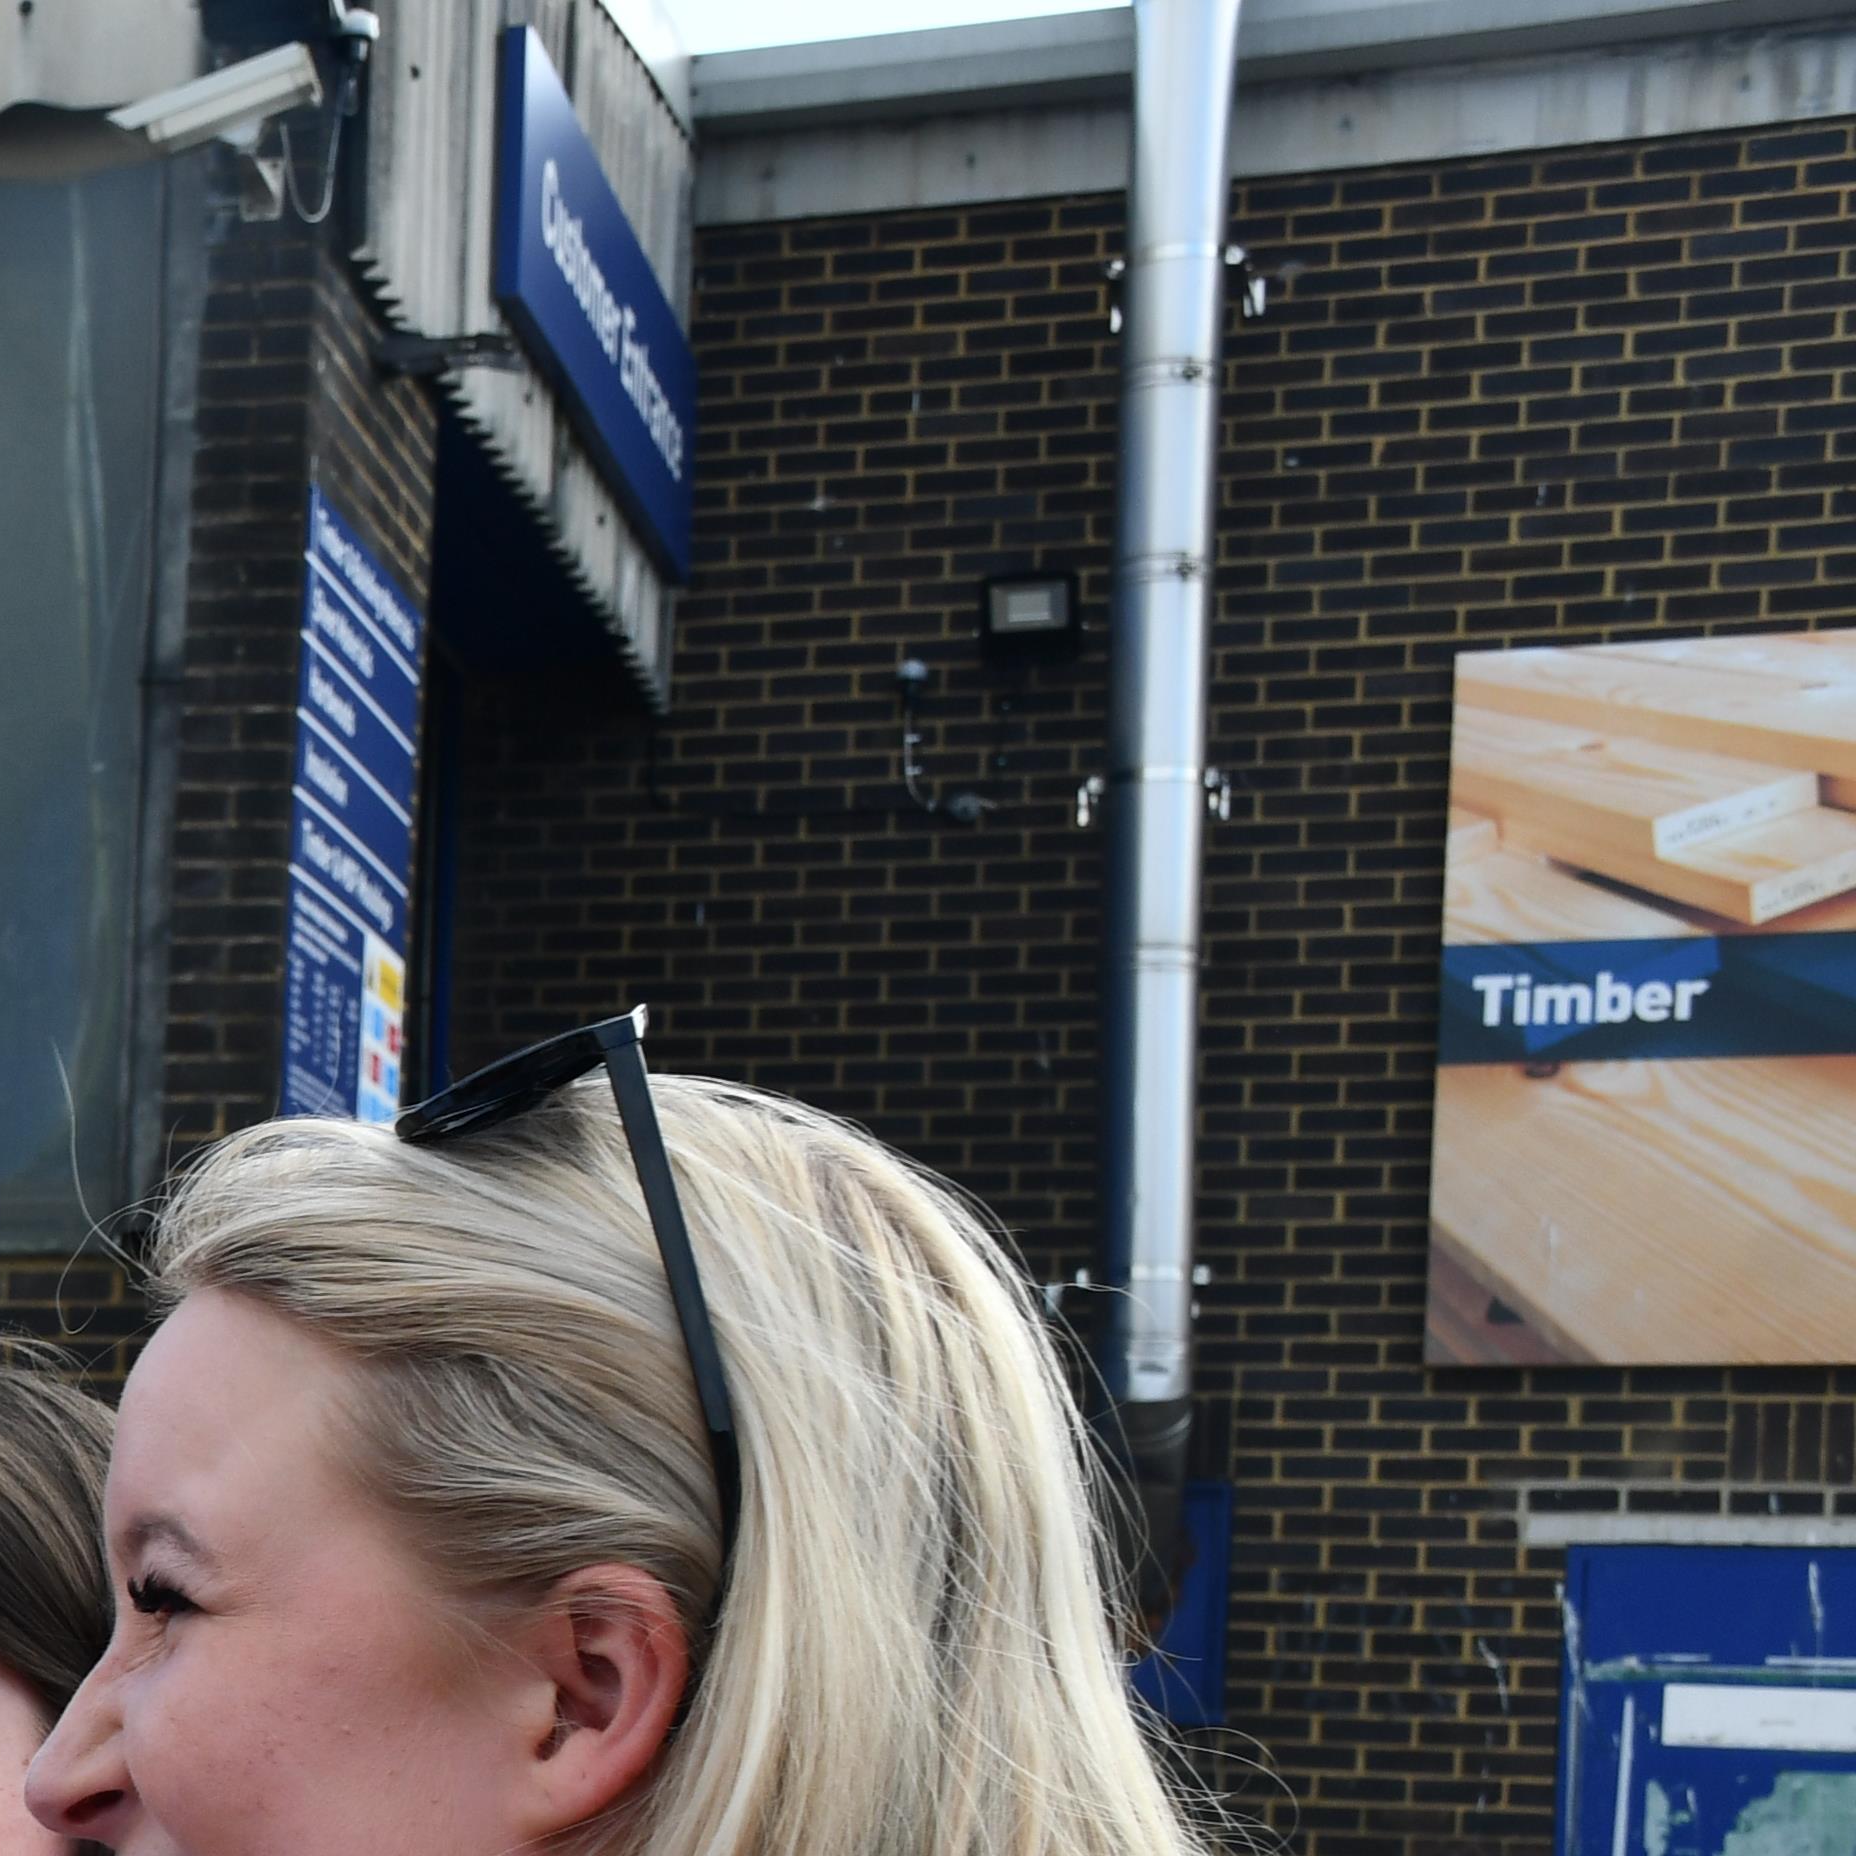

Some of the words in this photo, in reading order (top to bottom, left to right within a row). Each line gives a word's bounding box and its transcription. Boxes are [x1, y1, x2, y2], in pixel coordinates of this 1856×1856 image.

[541, 158, 622, 365] Customer
[620, 304, 684, 482] Entrance
[1472, 969, 1710, 1027] Timber
